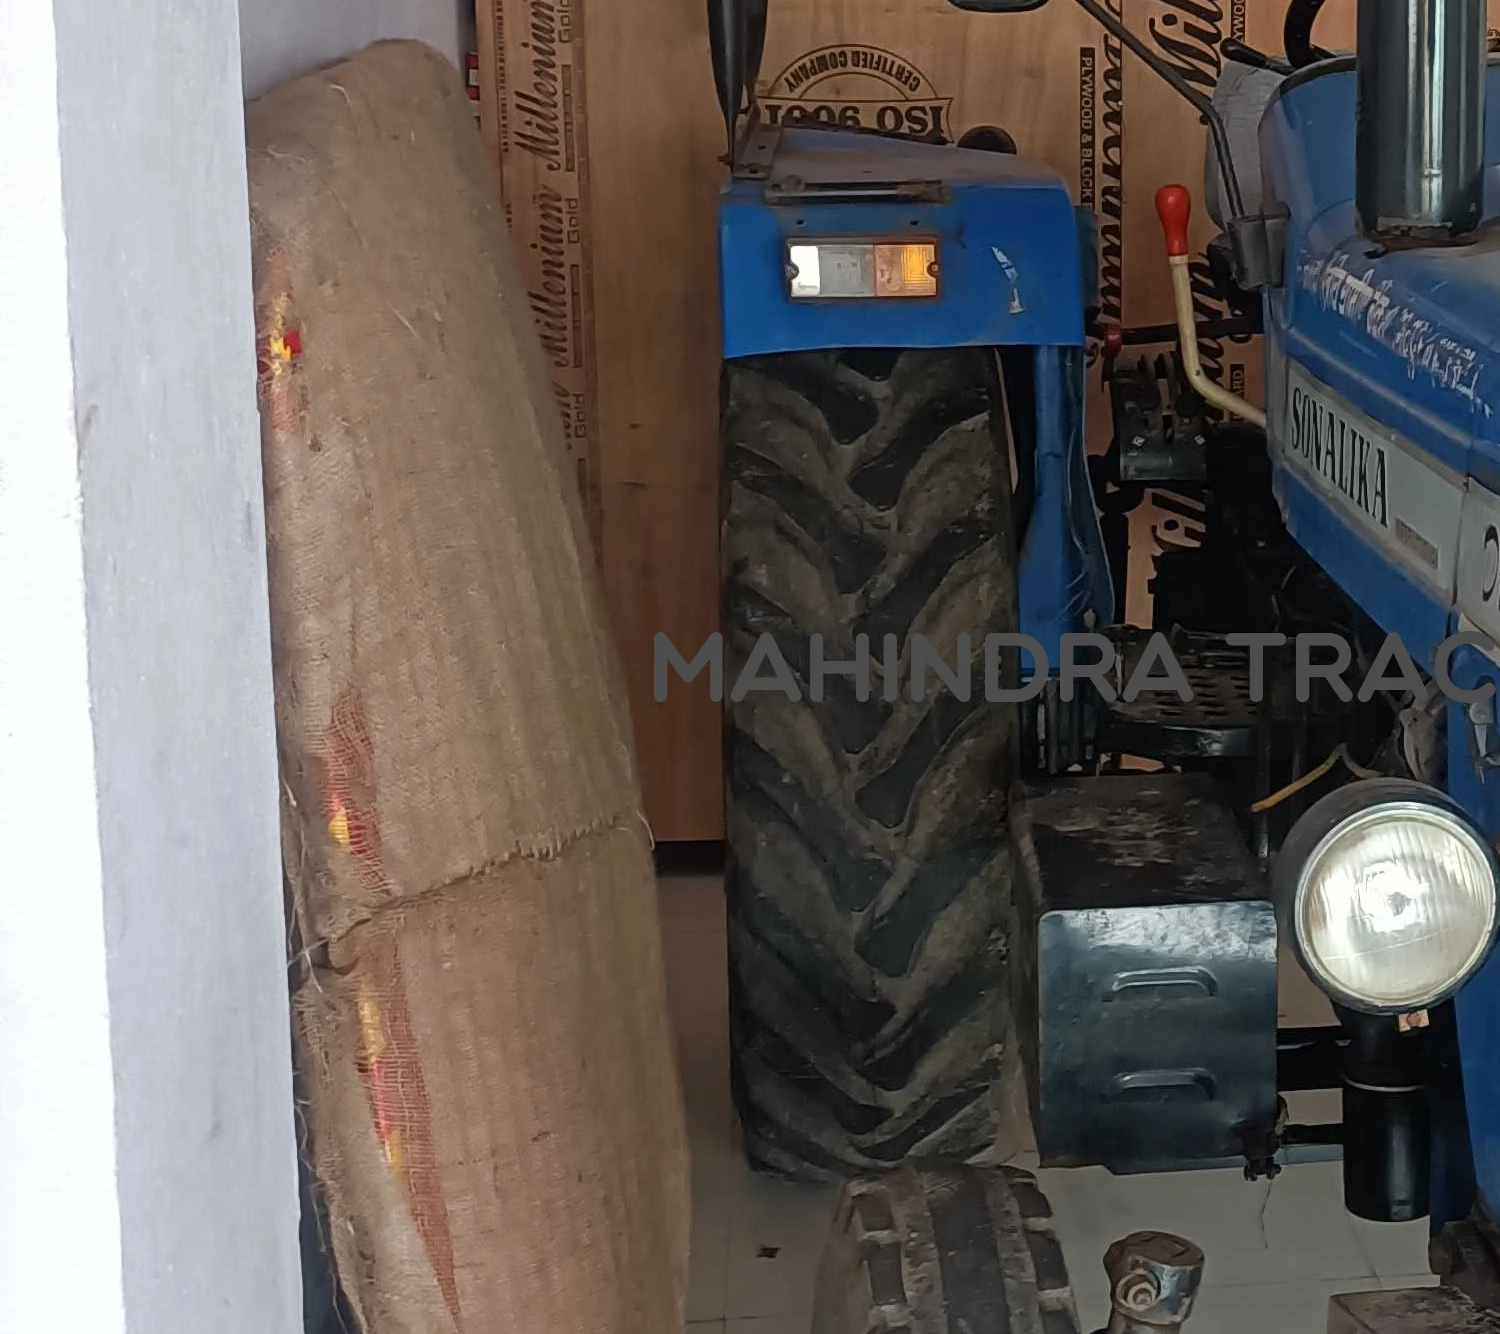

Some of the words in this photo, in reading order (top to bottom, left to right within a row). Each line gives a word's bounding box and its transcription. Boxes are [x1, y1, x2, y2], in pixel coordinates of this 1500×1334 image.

[783, 50, 848, 93] COMPANY
[851, 50, 921, 93] CERTIFIED
[1081, 57, 1093, 129] PLYWOOD
[876, 105, 944, 137] ISO
[1291, 386, 1390, 529] SONALIKA
